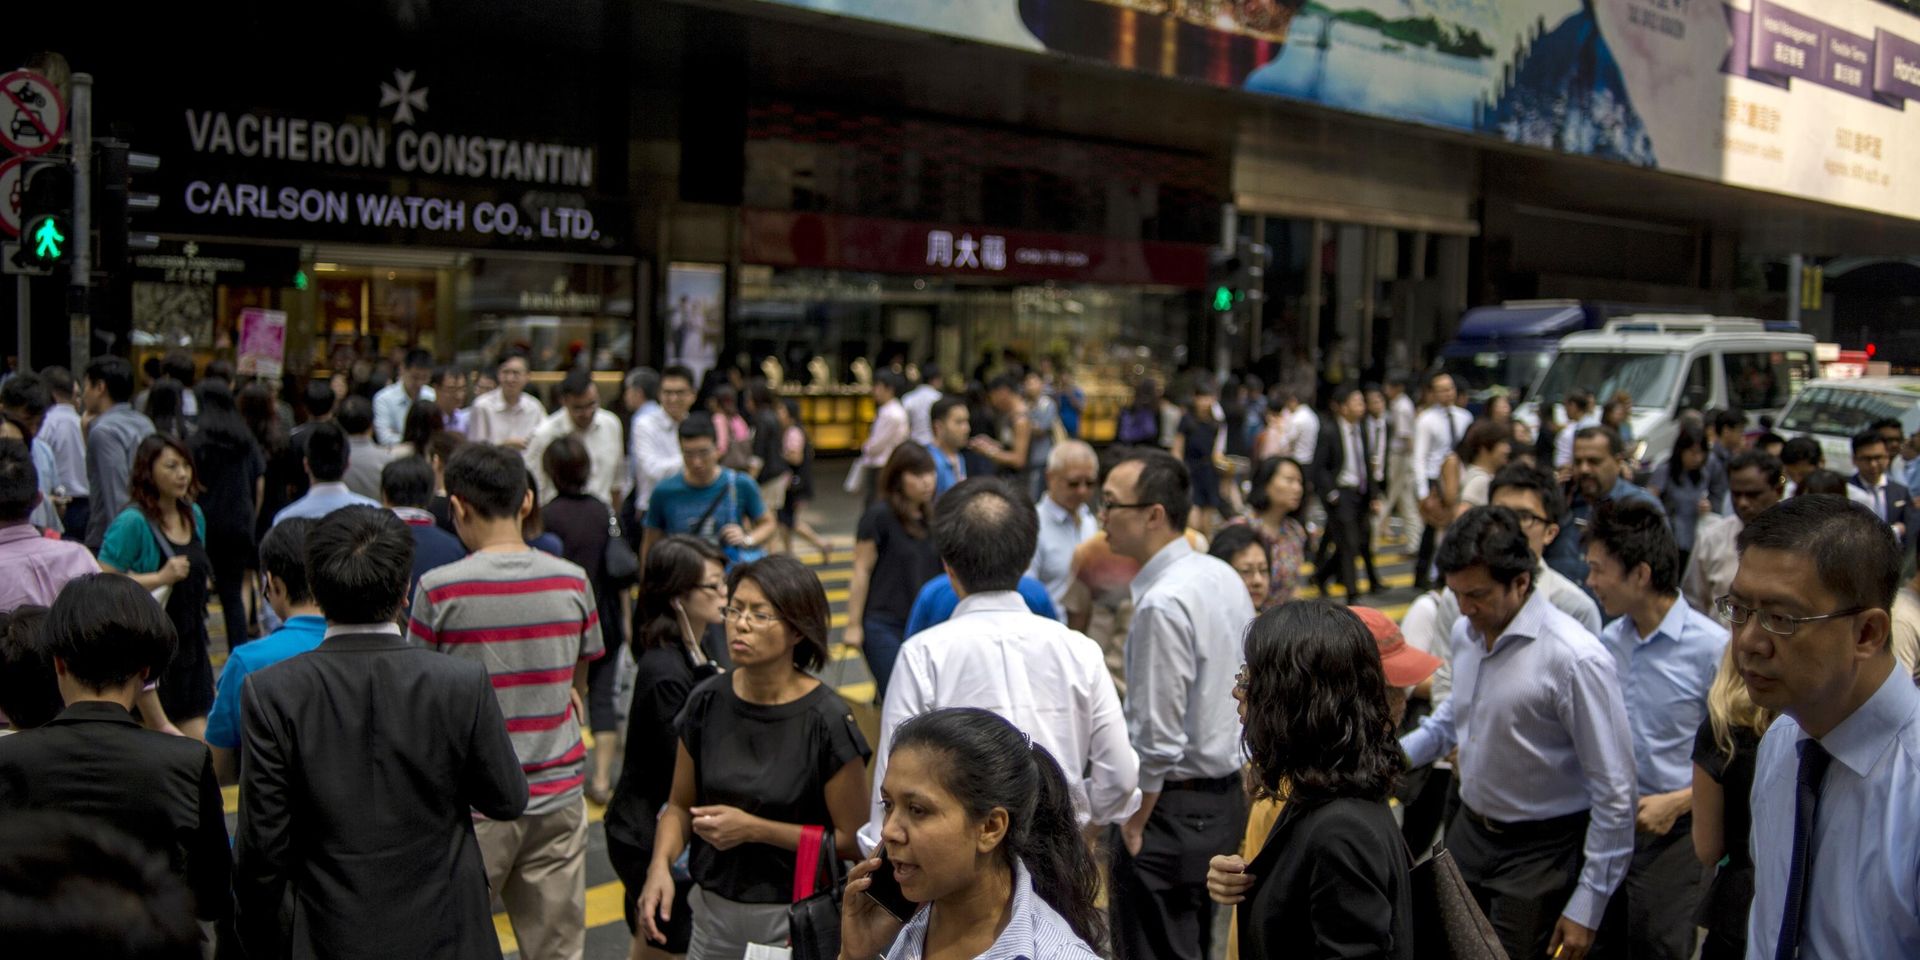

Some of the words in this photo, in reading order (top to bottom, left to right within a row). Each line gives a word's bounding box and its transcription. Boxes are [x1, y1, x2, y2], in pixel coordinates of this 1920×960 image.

[185, 109, 386, 168] VACHERON
[397, 129, 592, 187] CONSTANTIN
[185, 180, 348, 222] CARLSON
[356, 193, 465, 231] WATCH
[473, 202, 532, 240] CO.,
[541, 208, 600, 240] LTD.
